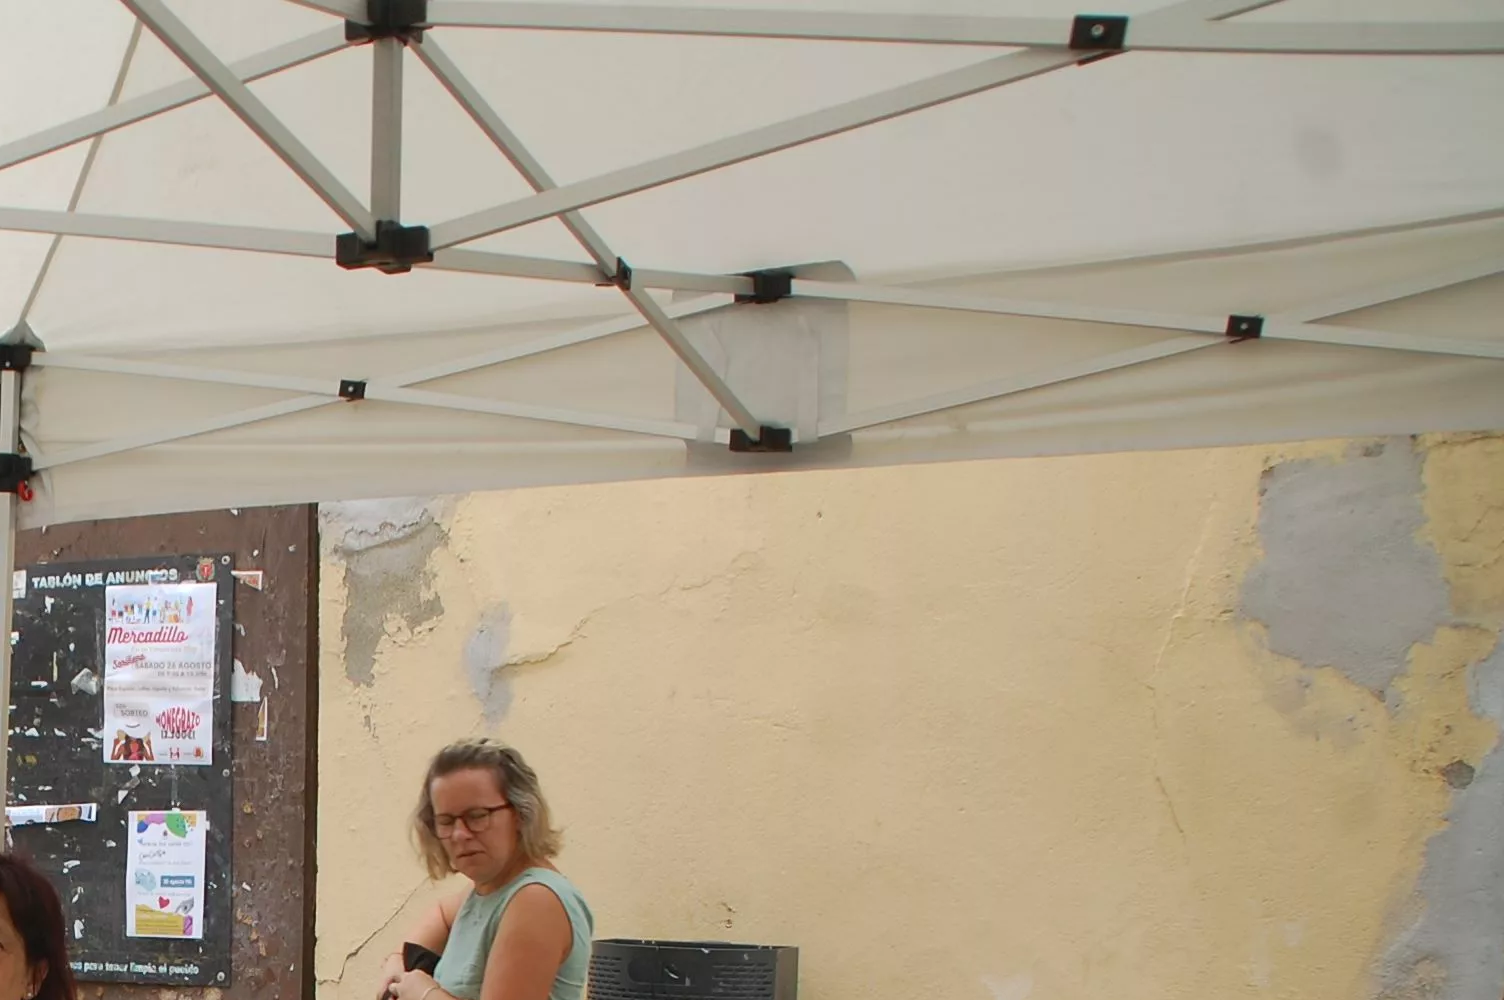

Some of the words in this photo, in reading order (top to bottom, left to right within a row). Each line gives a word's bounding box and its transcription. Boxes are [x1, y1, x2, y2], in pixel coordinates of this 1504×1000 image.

[31, 570, 82, 590] TABLÓN
[85, 571, 103, 587] DE
[105, 567, 178, 586] ANUNCOS
[107, 625, 189, 645] Mercadillo
[83, 961, 104, 973] para
[105, 962, 129, 973] tener
[158, 962, 168, 974] el
